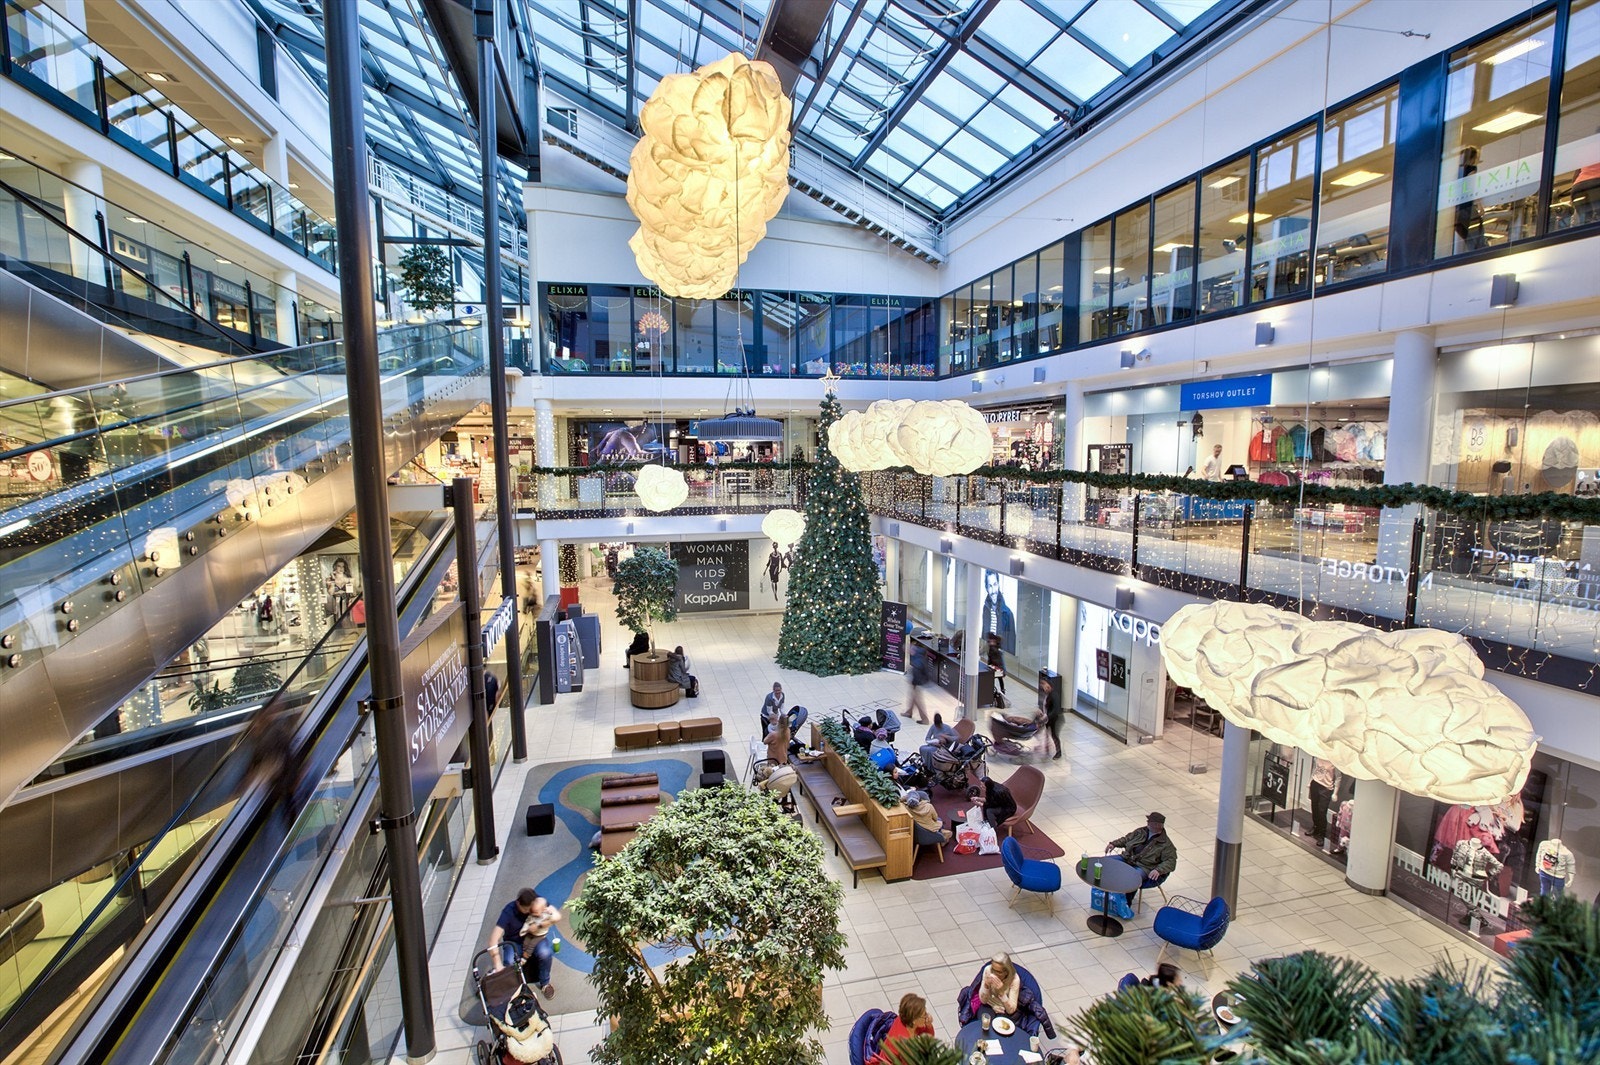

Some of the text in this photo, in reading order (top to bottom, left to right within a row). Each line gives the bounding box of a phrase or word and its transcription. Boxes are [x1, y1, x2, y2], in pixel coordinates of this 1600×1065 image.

[1448, 160, 1531, 198] ELIXIA
[215, 280, 247, 303] SOLHUSE
[551, 286, 585, 295] ELIXIA
[636, 288, 667, 297] ELIX
[721, 291, 751, 299] LIXIA
[872, 298, 901, 306] ELIXIA
[1193, 388, 1256, 400] TORSHOV OUTLET
[686, 544, 733, 554] WOMAN
[697, 557, 723, 566] MAN
[695, 569, 726, 578] KIDS
[703, 581, 719, 590] BY
[684, 591, 737, 606] KappAhl
[417, 650, 463, 723] SANDVIKA
[411, 666, 469, 764] STORSENTER
[1266, 772, 1283, 794] 3 2
